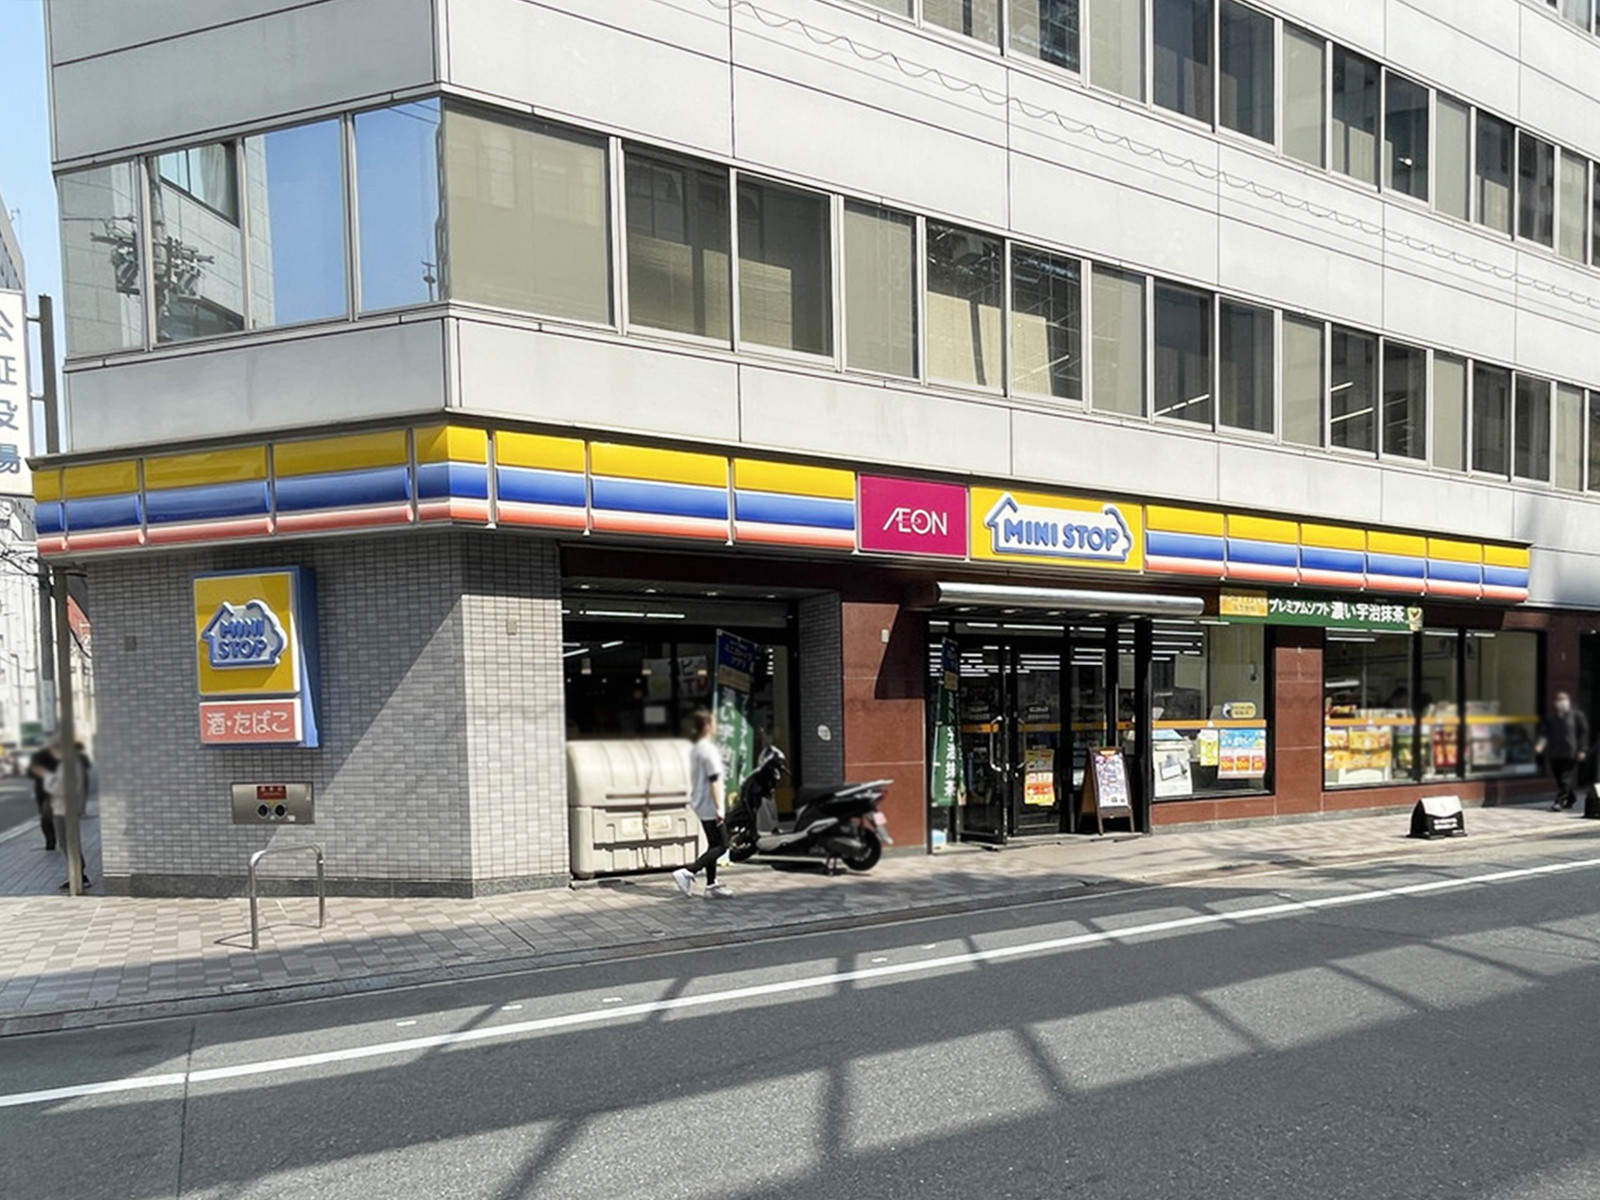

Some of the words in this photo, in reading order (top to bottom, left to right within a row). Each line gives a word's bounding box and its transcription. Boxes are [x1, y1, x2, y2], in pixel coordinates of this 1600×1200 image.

[1003, 518, 1059, 546] MINI
[1062, 523, 1120, 551] STOP
[1268, 598, 1330, 616] プレミアムソフト
[219, 617, 265, 639] MINI
[218, 637, 268, 660] STOP
[206, 709, 290, 737] 酒・たばこ
